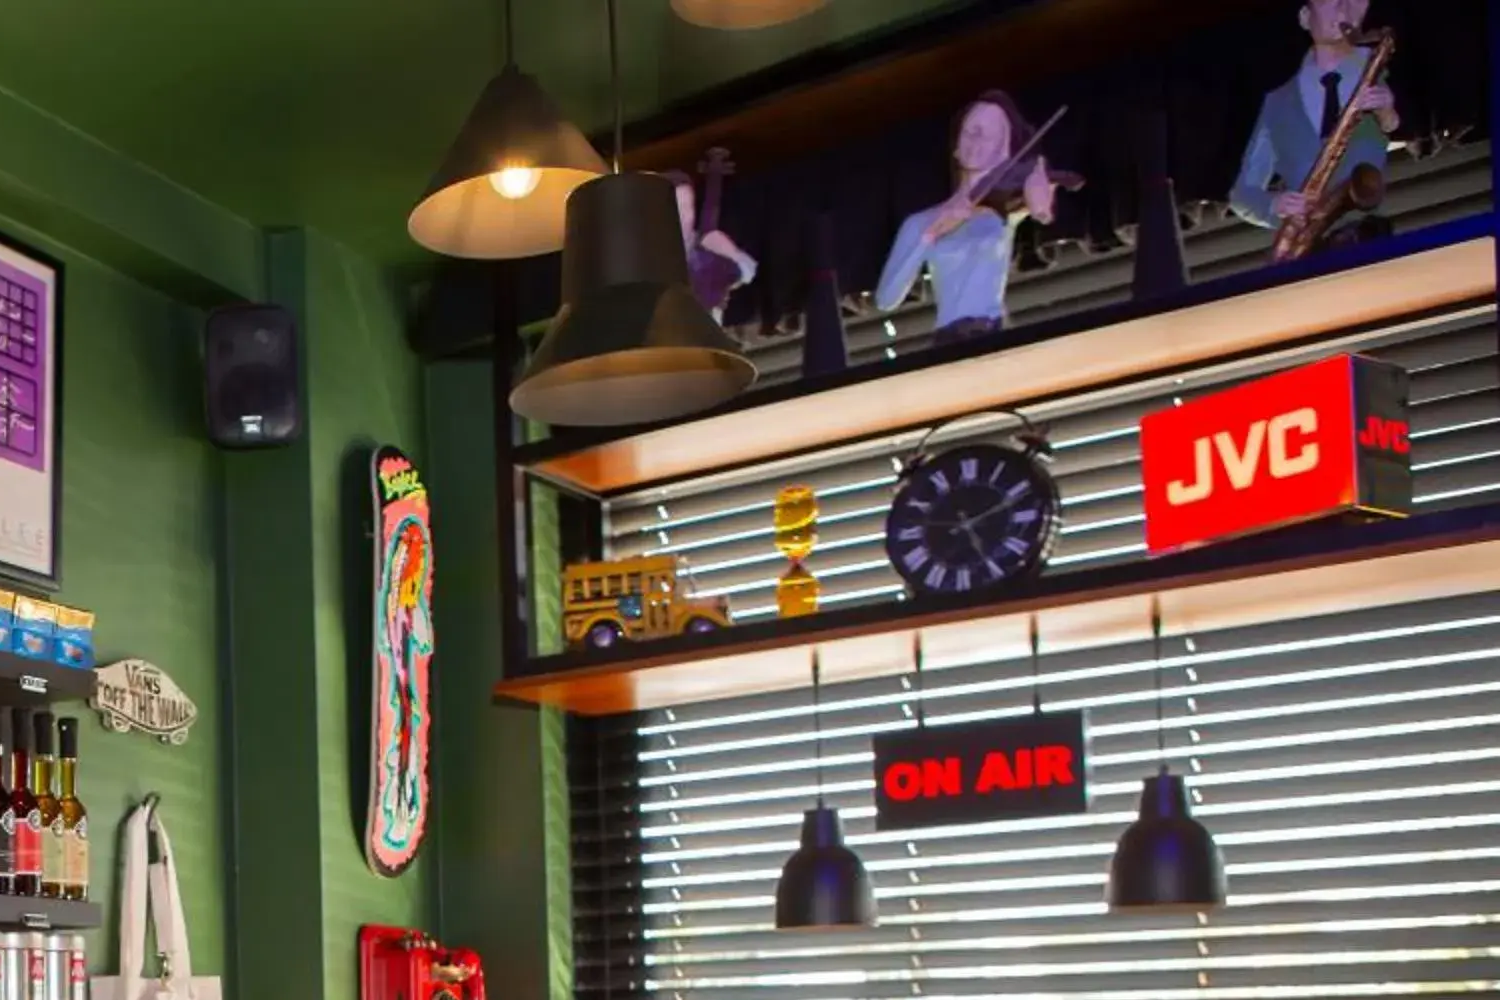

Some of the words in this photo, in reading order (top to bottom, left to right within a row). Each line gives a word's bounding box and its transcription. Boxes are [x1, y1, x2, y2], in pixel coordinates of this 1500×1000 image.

[1166, 407, 1319, 506] JVC
[1359, 415, 1411, 454] JVC
[125, 664, 161, 694] VANS
[883, 757, 962, 801] ON
[974, 744, 1075, 793] AIR
